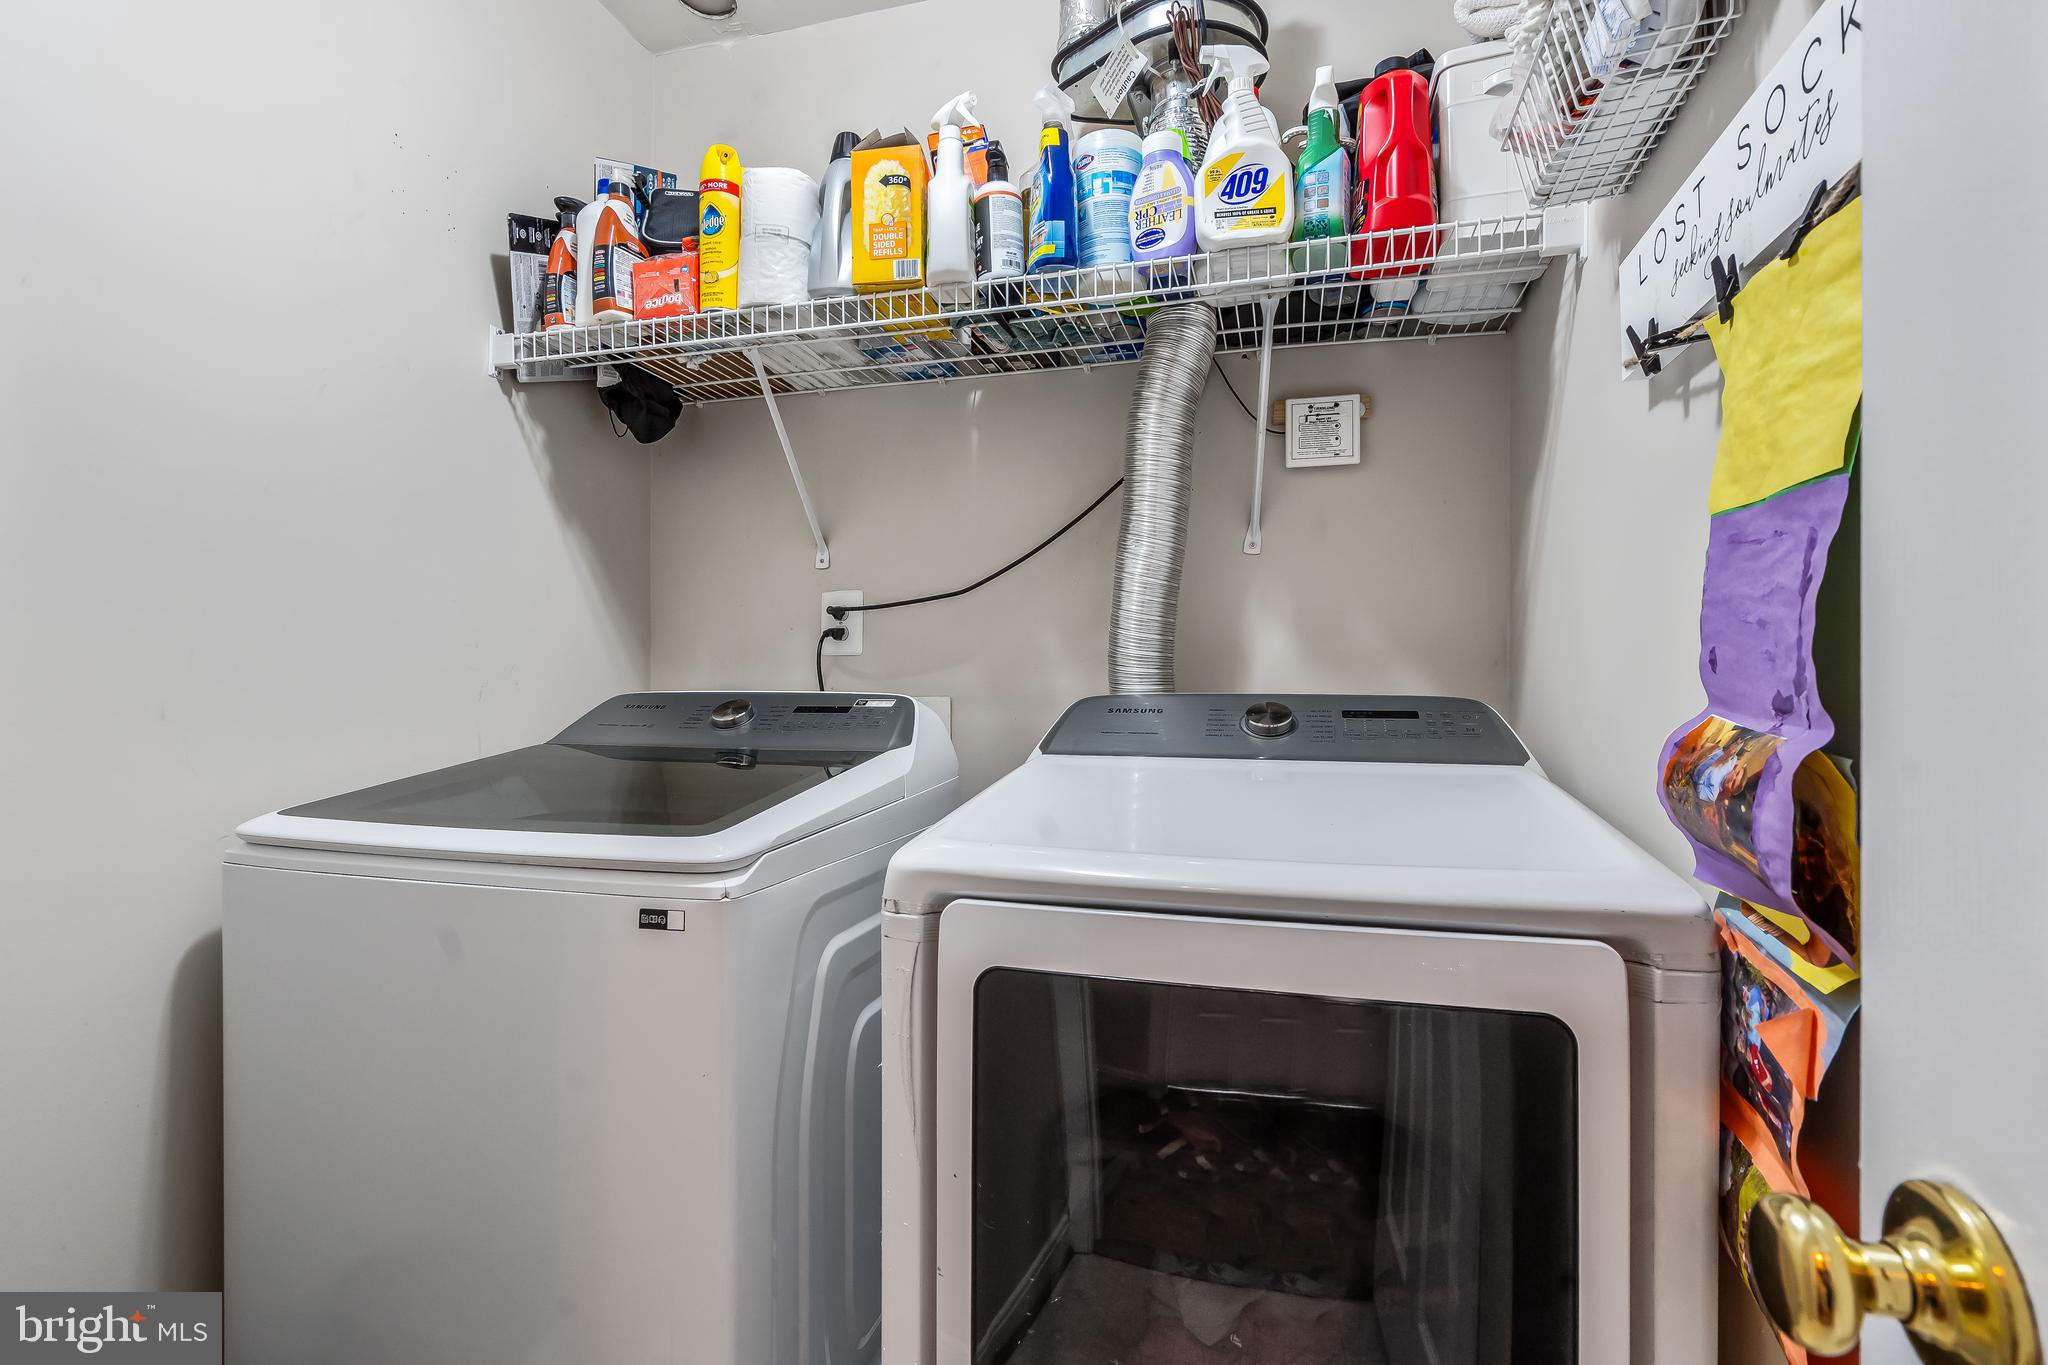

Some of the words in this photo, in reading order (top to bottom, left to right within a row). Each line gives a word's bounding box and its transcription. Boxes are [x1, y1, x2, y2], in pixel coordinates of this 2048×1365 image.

[1115, 70, 1137, 104] Caution!
[708, 182, 728, 190] MORE
[1221, 167, 1269, 200] 409
[1135, 206, 1157, 220] CPR
[1135, 209, 1182, 230] LEATHER
[873, 232, 903, 241] DOUBLE
[1639, 176, 1705, 286] LOST
[873, 240, 895, 249] SIDED
[873, 248, 903, 257] REFILLS
[1671, 212, 1724, 298] seeking
[645, 293, 682, 309] bounce
